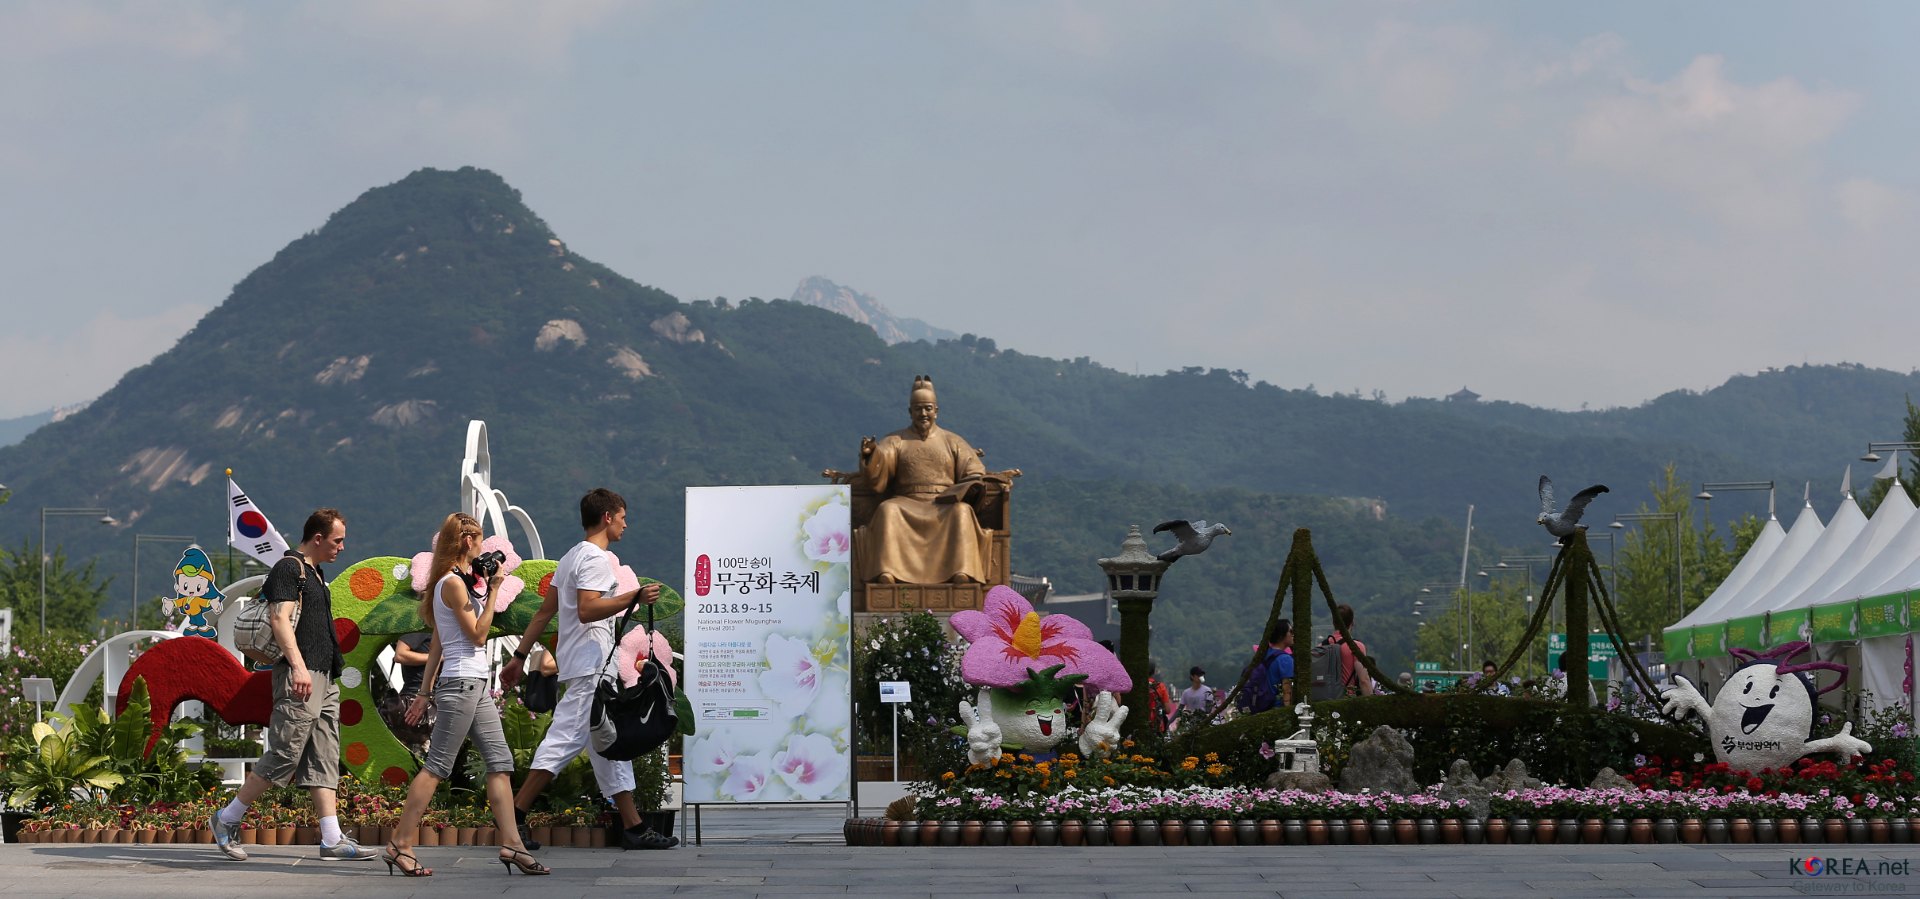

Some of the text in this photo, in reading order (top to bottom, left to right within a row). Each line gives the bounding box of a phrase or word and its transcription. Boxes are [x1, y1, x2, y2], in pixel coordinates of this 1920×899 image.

[717, 557, 772, 569] 100만 송이
[713, 570, 820, 595] 무궁화 축제
[1737, 740, 1781, 751] 부산광역시
